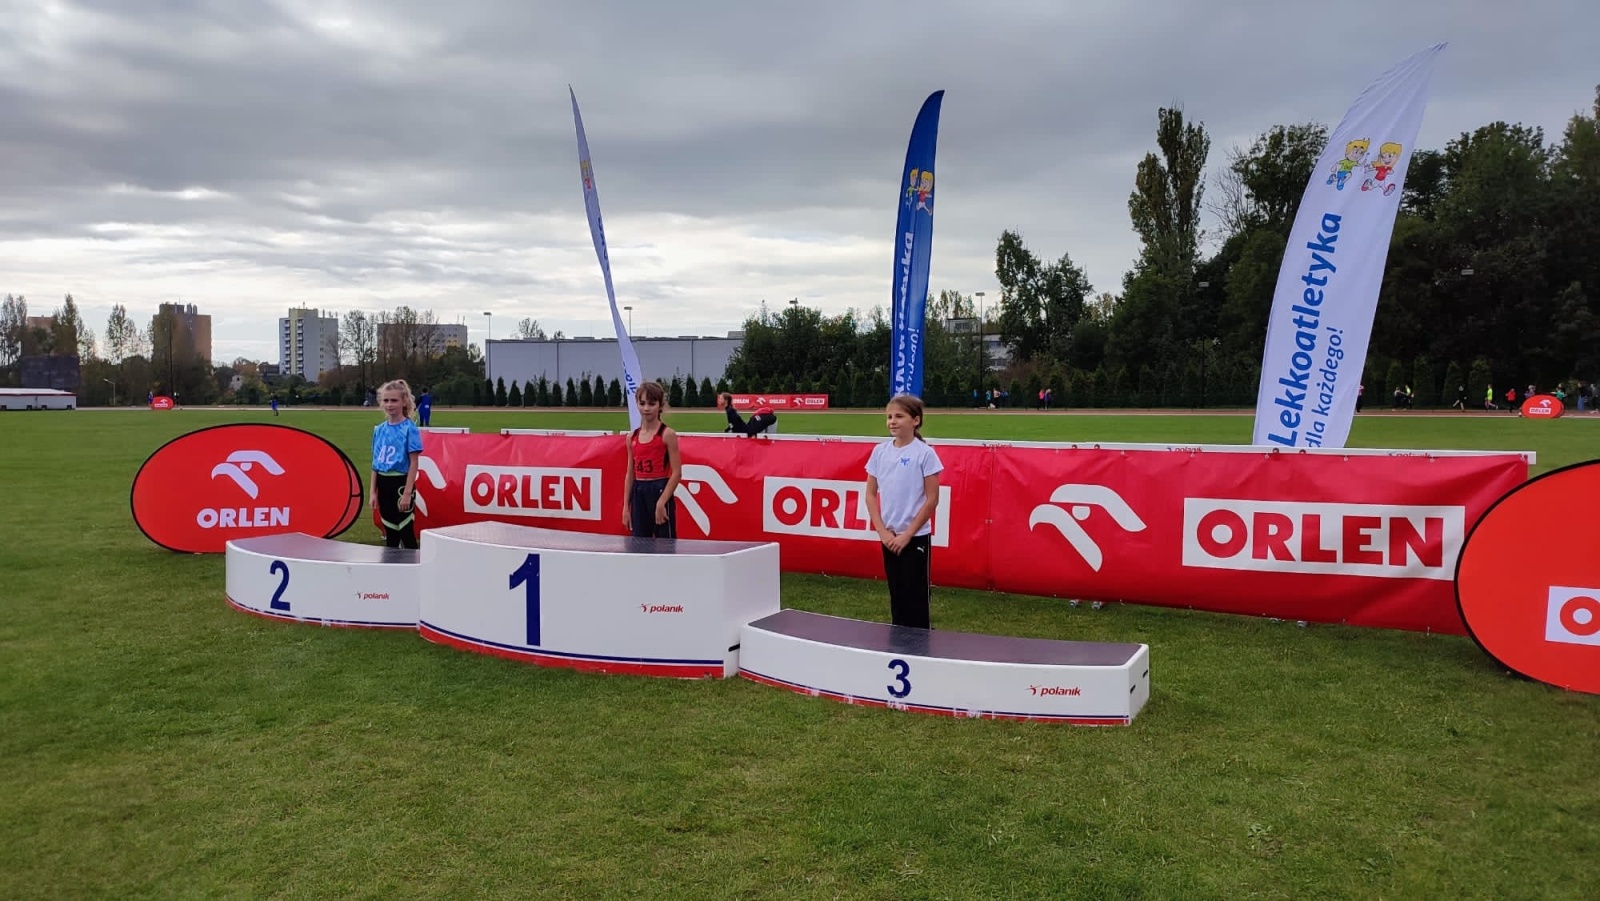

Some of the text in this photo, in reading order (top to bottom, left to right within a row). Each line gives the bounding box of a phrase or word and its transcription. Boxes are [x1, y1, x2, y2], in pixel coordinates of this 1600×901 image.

[1267, 213, 1342, 447] Lekkoatletyka
[1311, 326, 1344, 417] każdego!
[378, 445, 396, 465] 42
[637, 459, 653, 474] 43
[470, 472, 591, 511] ORLEN
[196, 506, 290, 528] ORLEN
[1197, 509, 1443, 568] ORLEN
[269, 560, 291, 611] 2
[363, 592, 390, 600] polanik
[509, 553, 541, 646] 1
[649, 604, 684, 614] polanik
[886, 658, 912, 698] 3
[1040, 684, 1081, 698] polanik
